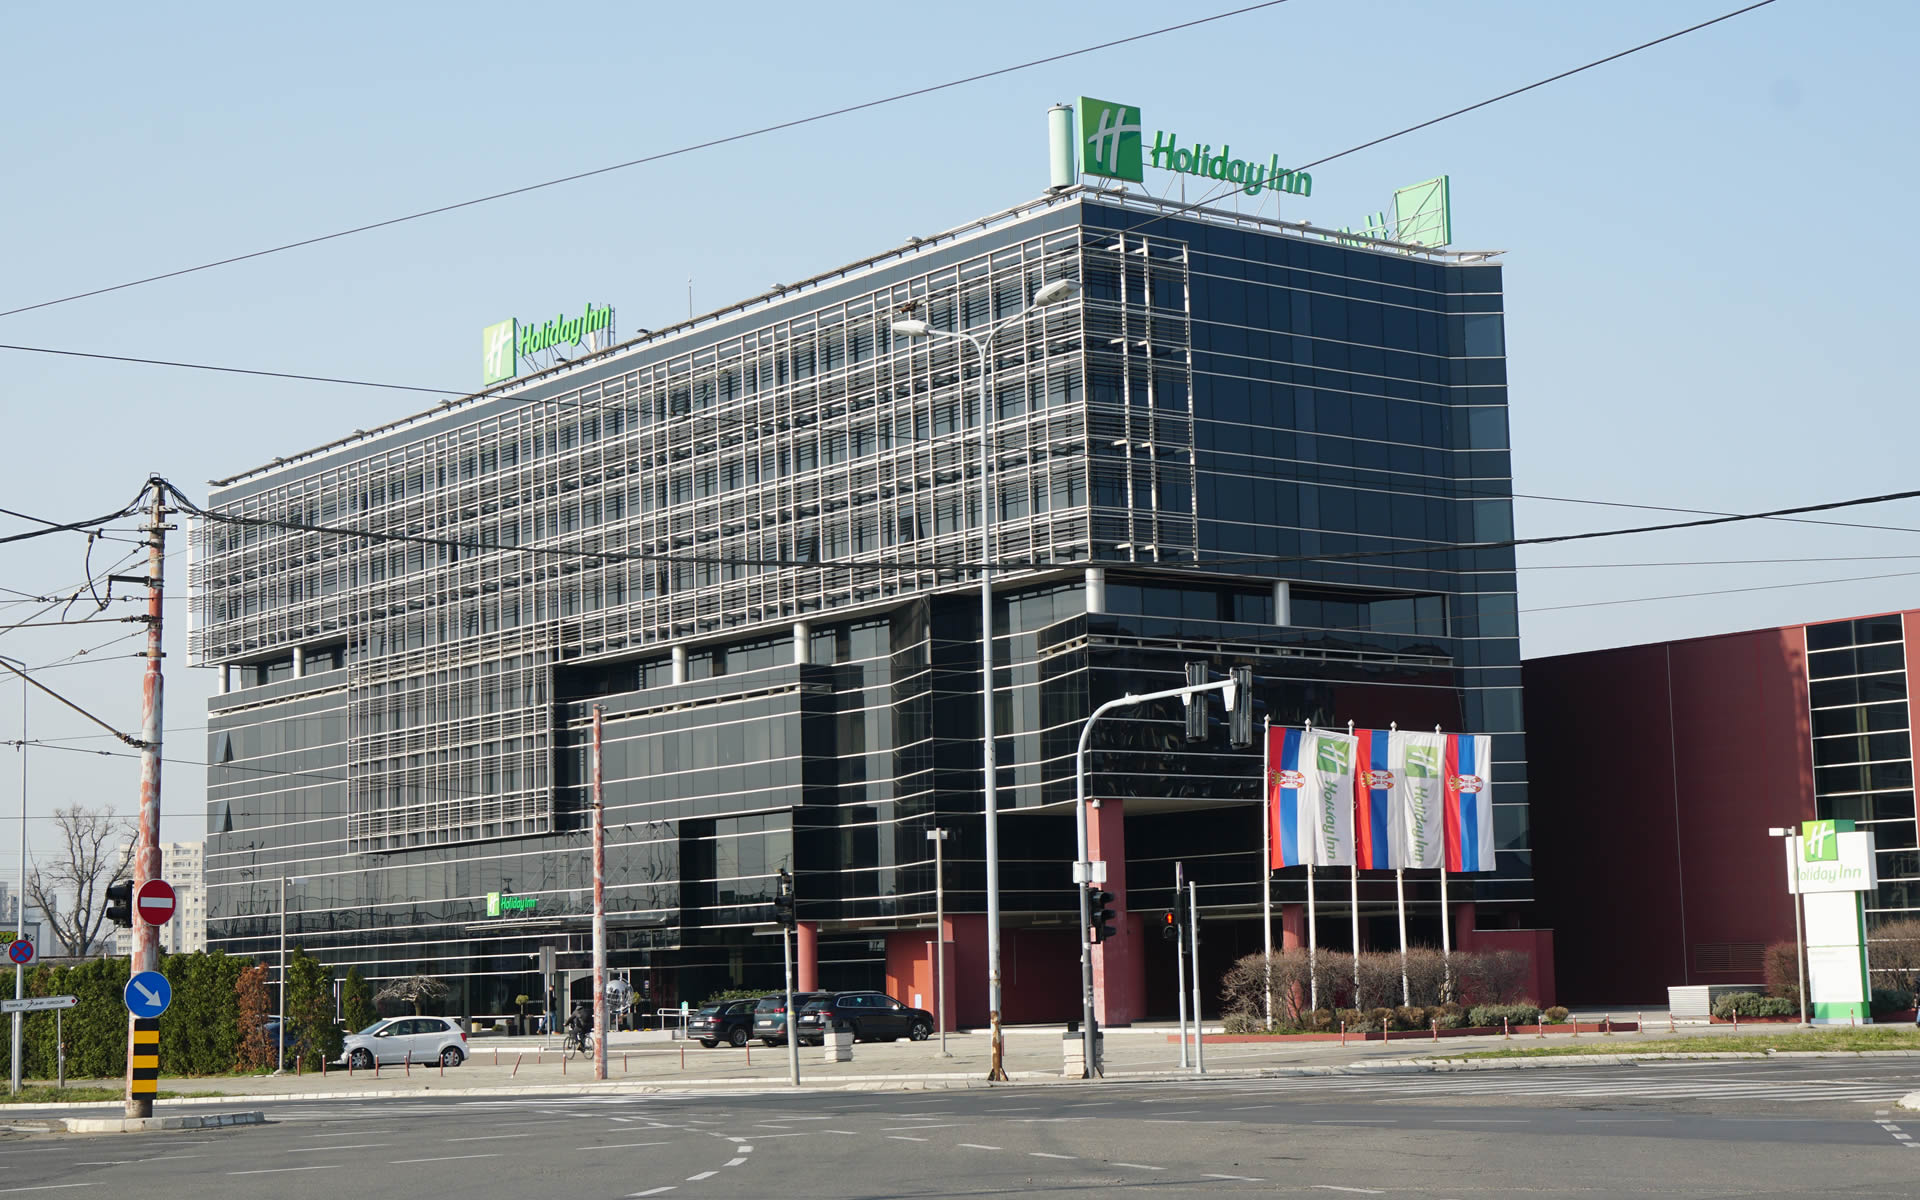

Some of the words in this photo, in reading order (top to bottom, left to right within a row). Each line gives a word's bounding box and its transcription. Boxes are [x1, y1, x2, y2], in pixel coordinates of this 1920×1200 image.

[1150, 130, 1264, 196] Holiday
[1268, 153, 1312, 197] Inn
[519, 313, 584, 357] Holiday
[583, 302, 612, 334] Inn
[1322, 780, 1338, 833] Holiday
[1411, 786, 1428, 841] Holiday
[1326, 837, 1340, 859] Inn
[1414, 842, 1429, 862] Inn
[1839, 863, 1862, 880] Inn
[501, 896, 525, 911] Holiday
